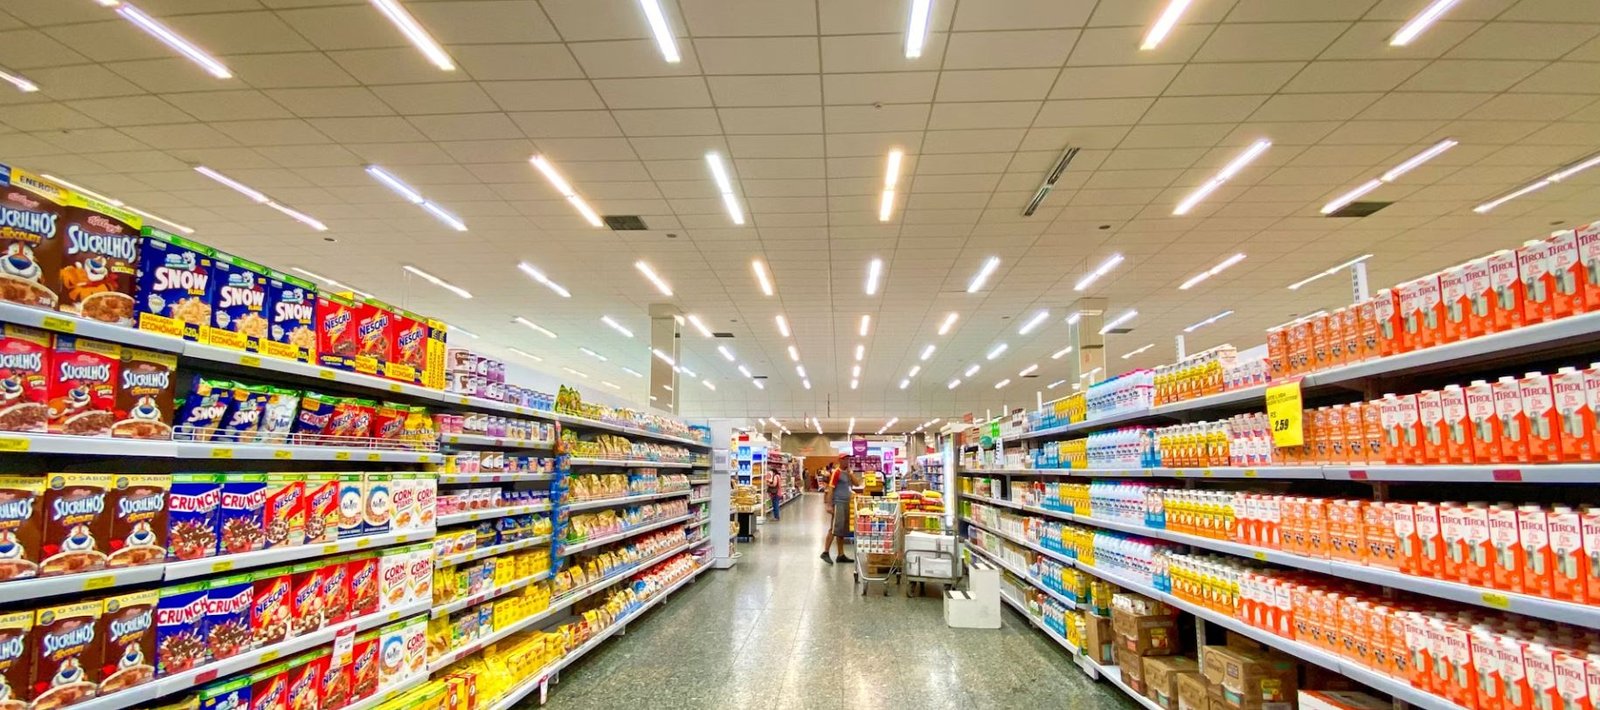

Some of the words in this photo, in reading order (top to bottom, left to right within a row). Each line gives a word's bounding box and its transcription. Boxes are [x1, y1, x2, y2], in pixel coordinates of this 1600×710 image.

[0, 207, 58, 239] UCRILHOS
[67, 225, 137, 264] SUCRILHOS
[1580, 233, 1600, 246] TIRO
[1548, 242, 1575, 256] TIROL
[1491, 262, 1515, 273] TIROL
[1520, 252, 1547, 265] TIROL
[153, 266, 208, 291] SNOW
[1465, 270, 1488, 281] TIROL
[220, 285, 265, 308] SNOW
[275, 302, 313, 322] SNOW
[324, 312, 351, 331] NESCAU
[359, 316, 389, 338] NESCAU
[399, 329, 424, 347] NESCAU
[0, 352, 42, 373] UCRILHOS
[60, 362, 111, 383] SUCRILHOS
[122, 370, 170, 389] SUCRILHOS
[1494, 391, 1520, 401] TIROL
[1522, 387, 1549, 398] TIROL
[1554, 383, 1583, 394] TIROL
[1468, 395, 1493, 404] TIROL
[188, 404, 228, 422] SNOW
[229, 409, 260, 428] SNO
[169, 489, 220, 510] CRUNCH
[222, 489, 267, 508] CRUNCH
[393, 489, 412, 503] CORN
[53, 493, 105, 521] SUCRILHOS
[119, 493, 164, 518] SUCRILHOS
[1490, 519, 1514, 529] TIROL
[1521, 521, 1545, 532] TIROL
[1550, 523, 1578, 534] TIROL
[1584, 525, 1600, 534] TIR
[385, 564, 404, 581] CORN
[411, 560, 429, 575] CORN
[207, 589, 254, 613] CRUNCH
[255, 584, 288, 614] NESCAU
[158, 597, 208, 625] CRUNCH
[111, 609, 152, 642] SUCRILHOS
[44, 621, 95, 657] SUCRILHOS
[1525, 658, 1553, 672] TIROL
[1556, 665, 1583, 681] TIROL
